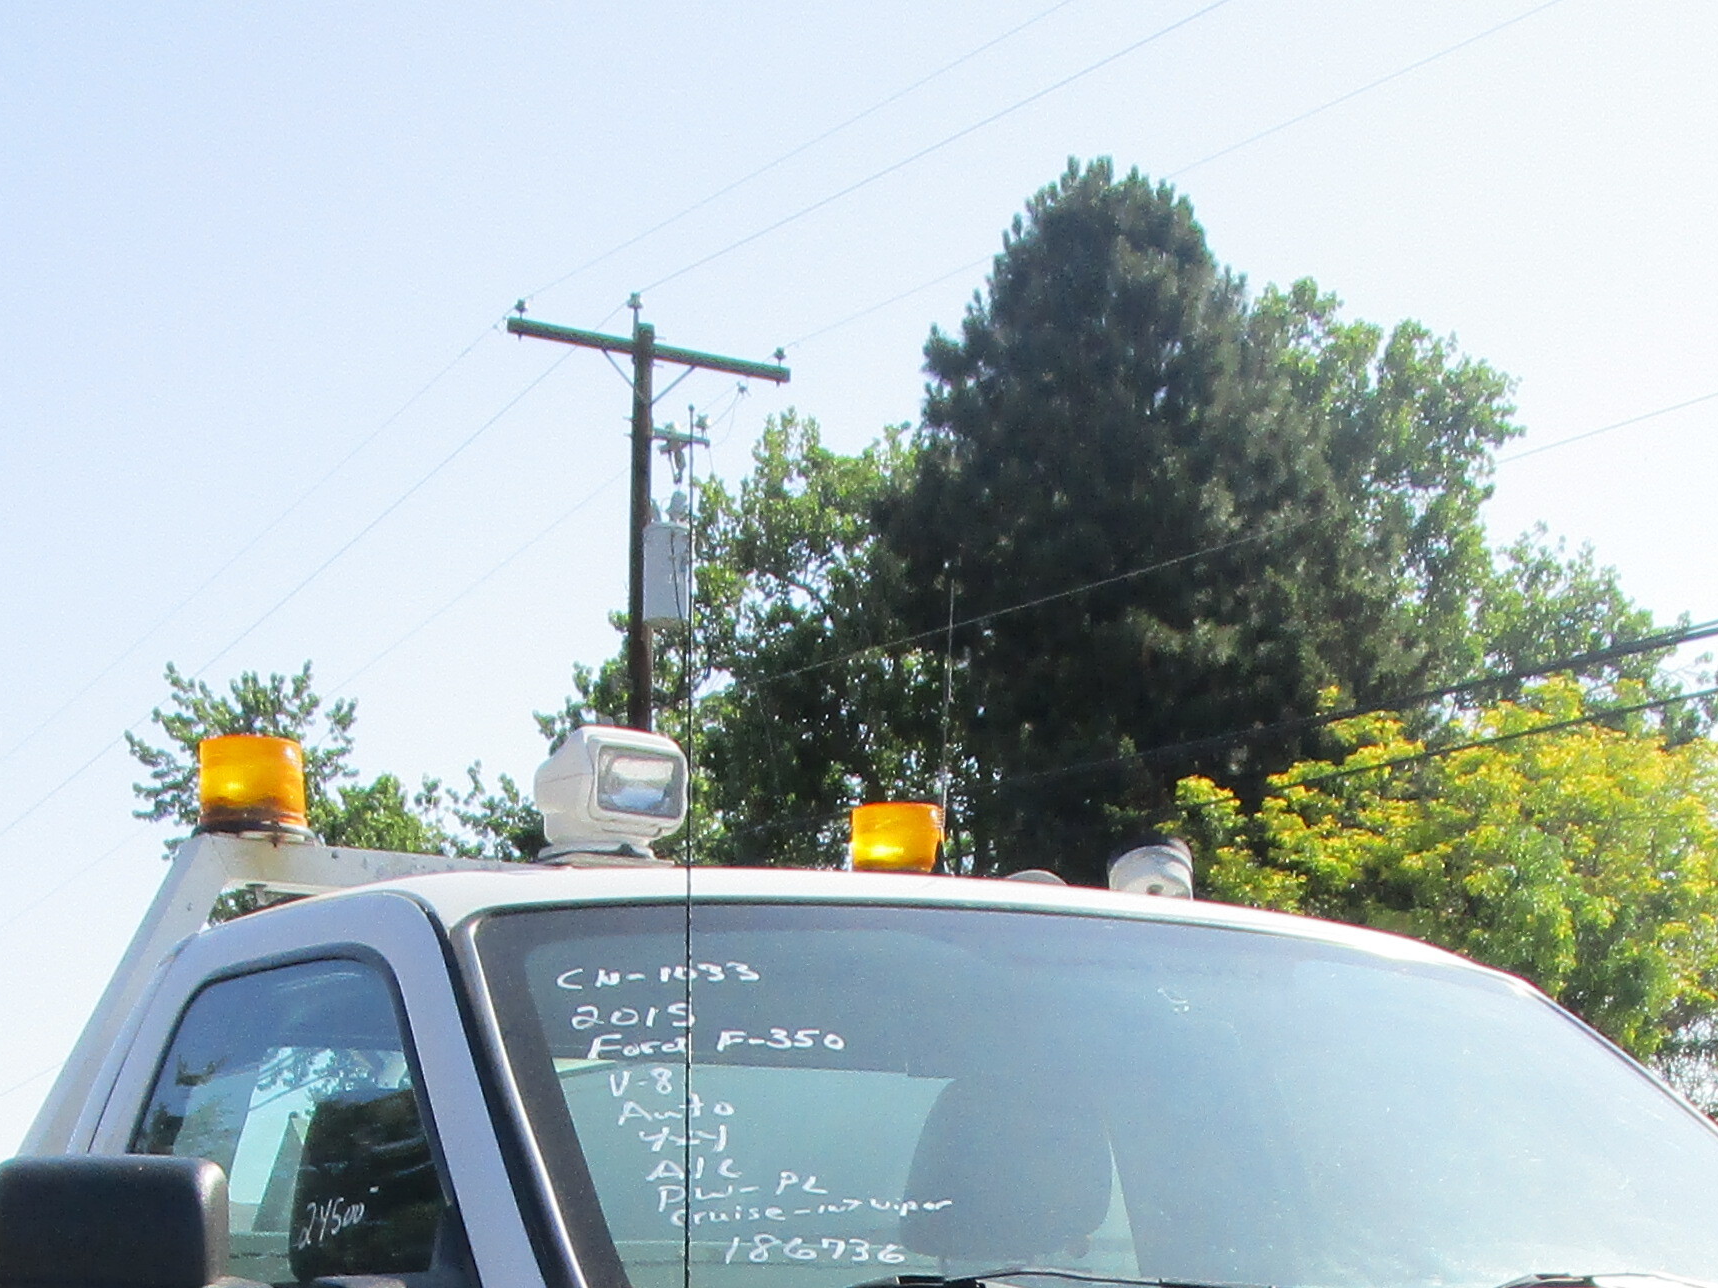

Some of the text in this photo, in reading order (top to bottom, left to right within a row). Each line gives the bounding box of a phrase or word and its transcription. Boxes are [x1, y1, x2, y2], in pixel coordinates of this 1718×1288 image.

[586, 1028, 846, 1060] Ford F-350
[609, 1067, 673, 1097] V-8
[617, 1092, 735, 1126] Auto
[725, 1233, 906, 1264] 186736
